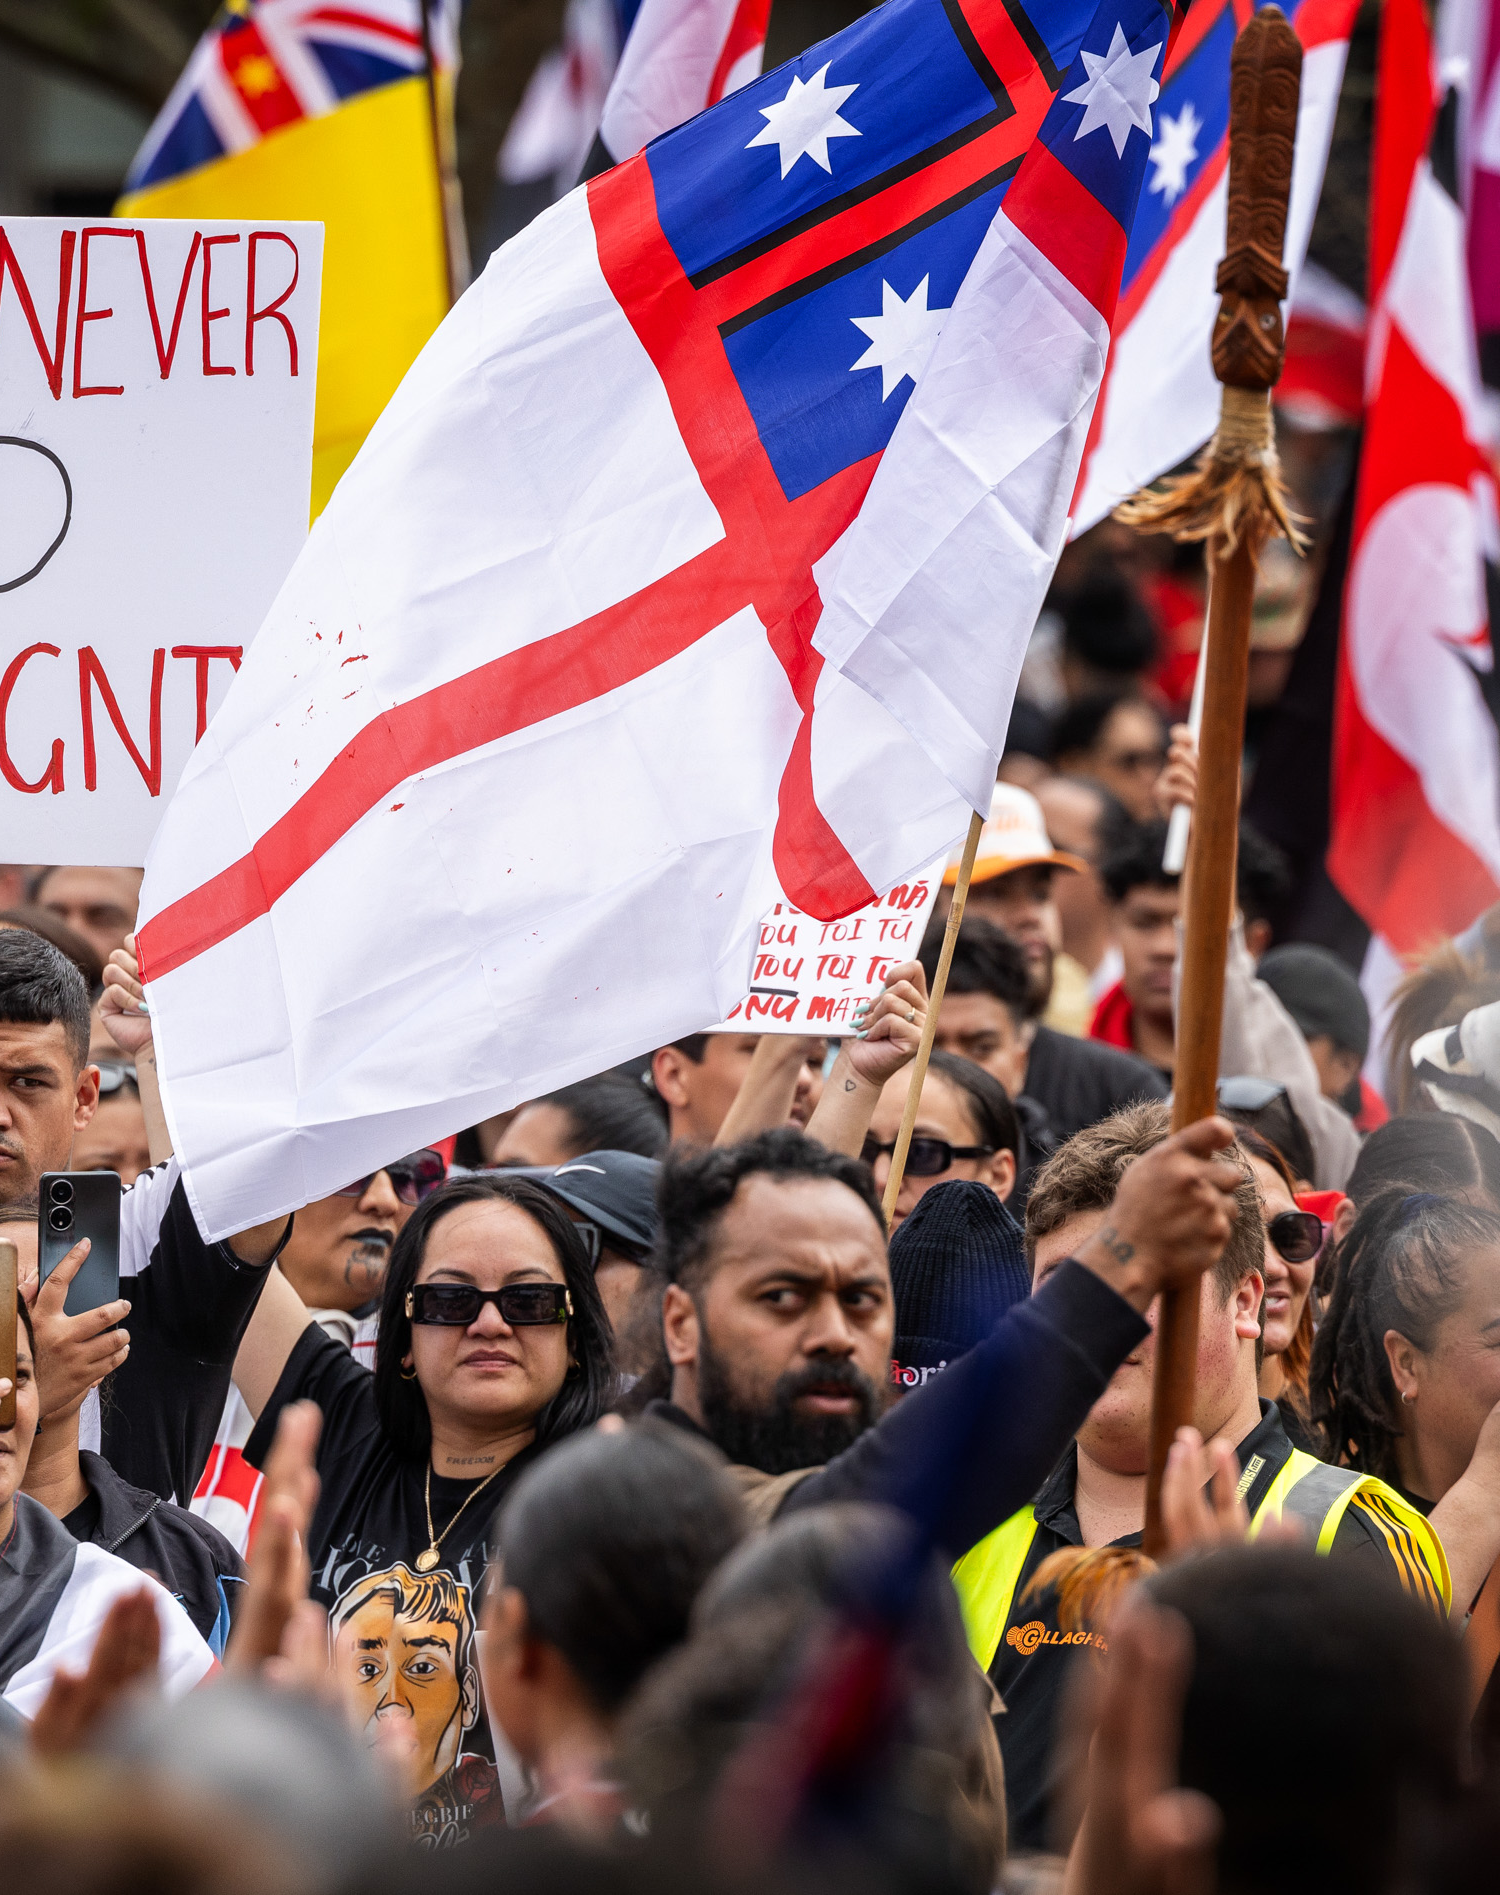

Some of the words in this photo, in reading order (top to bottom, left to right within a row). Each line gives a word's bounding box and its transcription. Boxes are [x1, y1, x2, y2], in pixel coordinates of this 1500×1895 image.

[760, 922, 797, 946] OU
[818, 918, 867, 945] TOI
[879, 914, 913, 942] TŪ
[817, 954, 857, 981] TOI
[806, 987, 871, 1022] MĀT
[445, 1456, 495, 1465] FREEDOM
